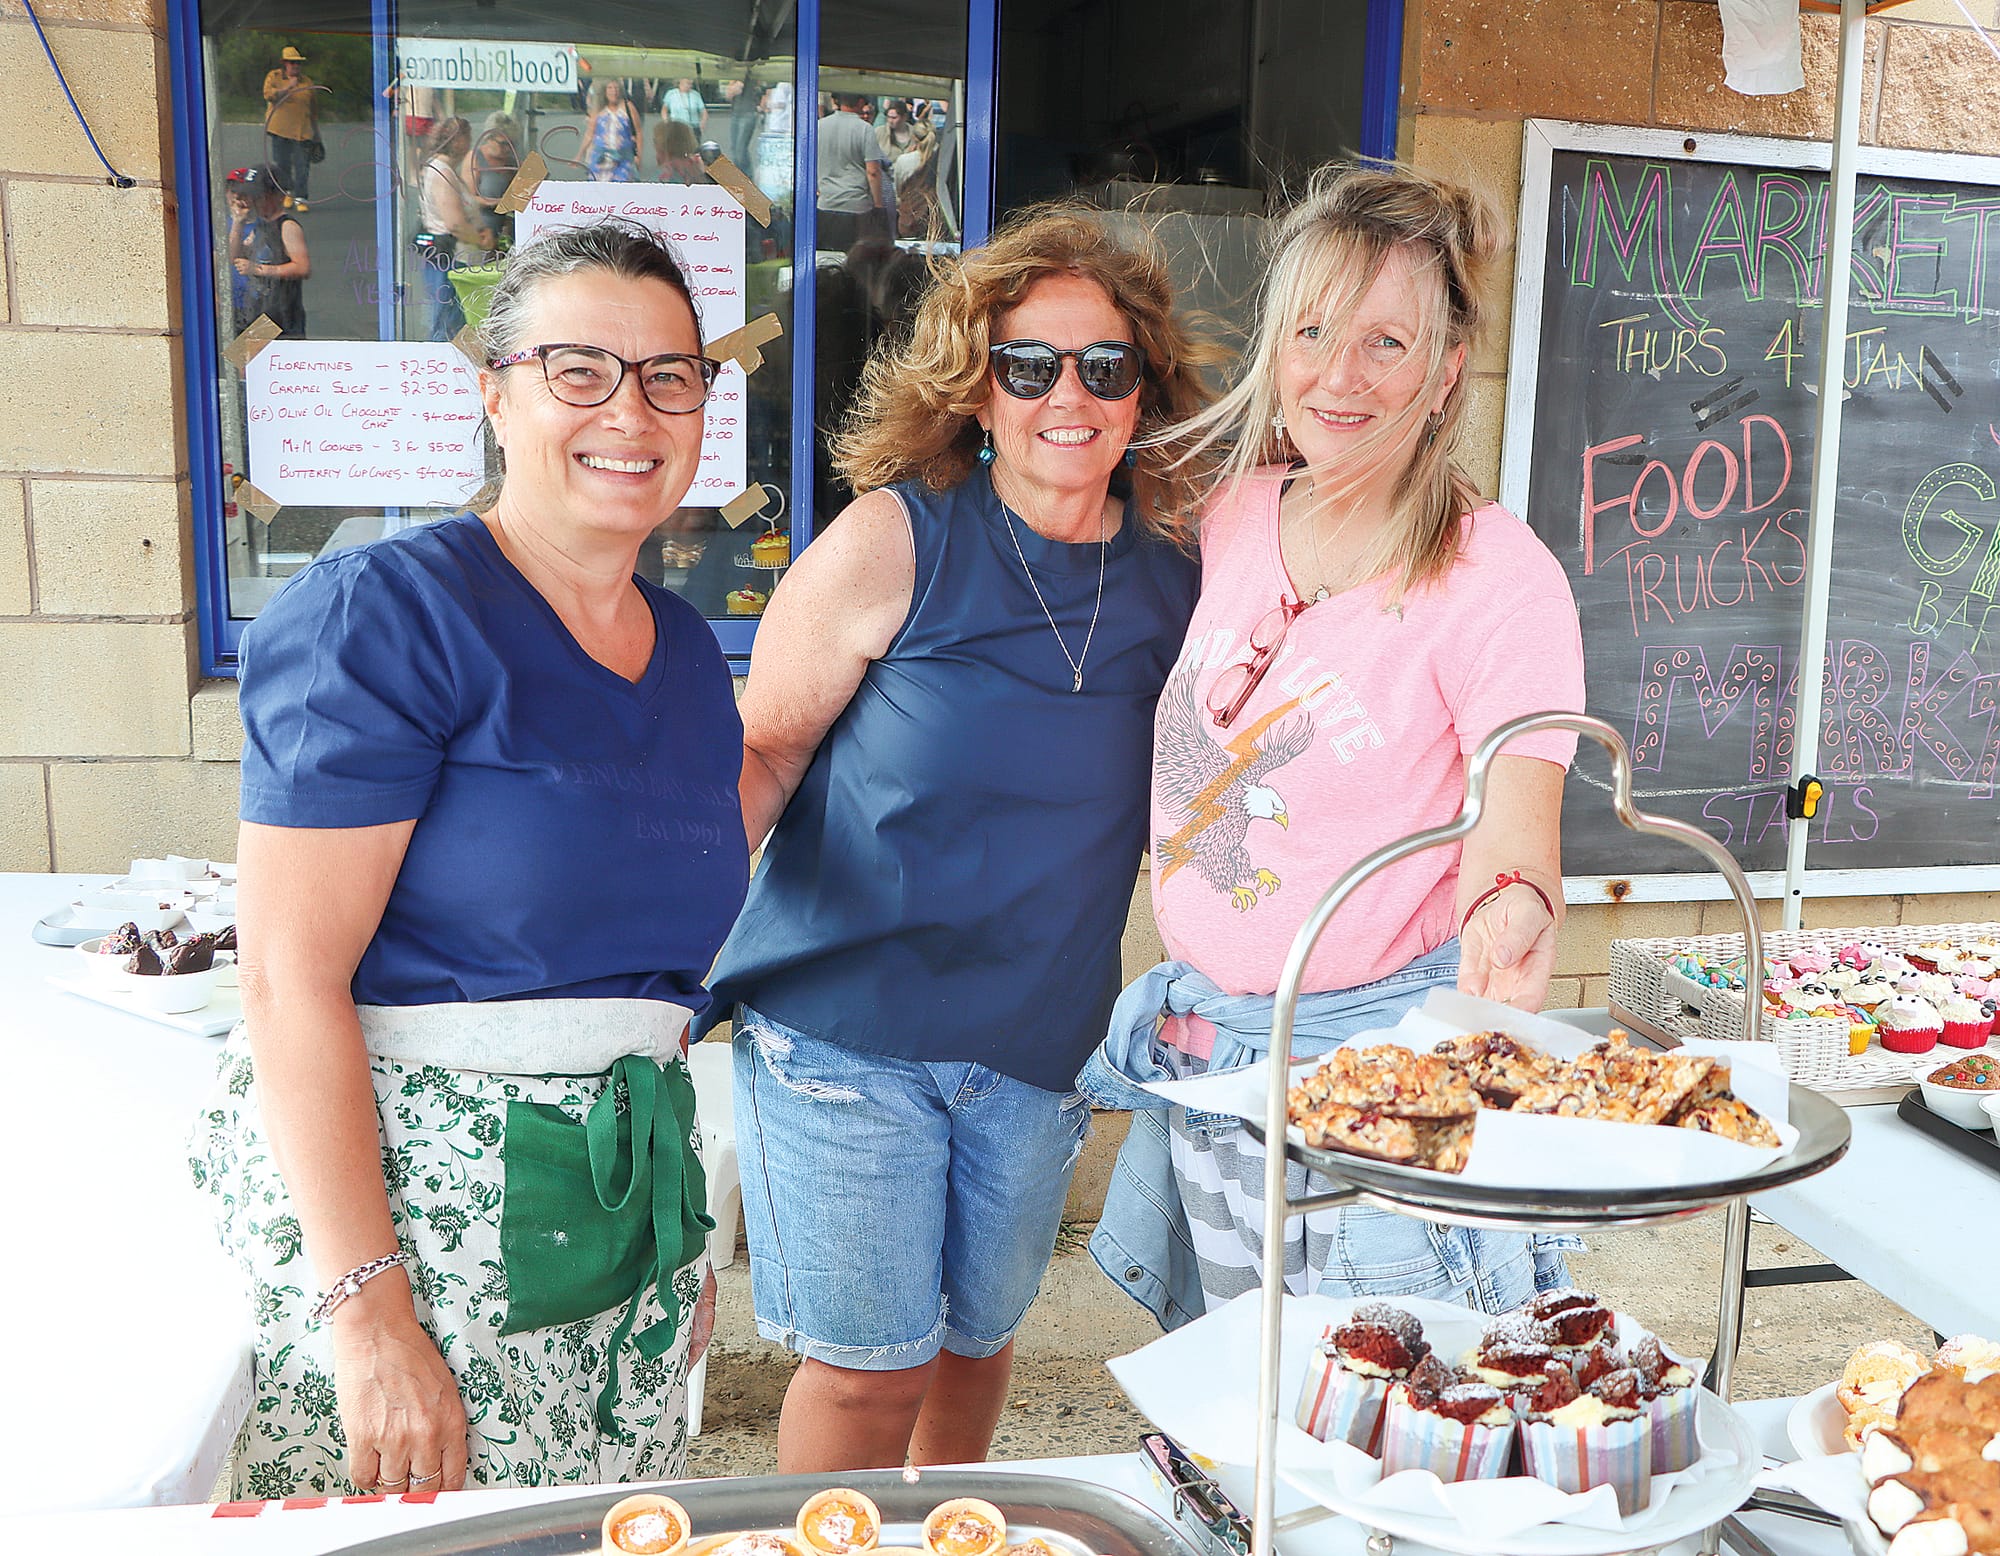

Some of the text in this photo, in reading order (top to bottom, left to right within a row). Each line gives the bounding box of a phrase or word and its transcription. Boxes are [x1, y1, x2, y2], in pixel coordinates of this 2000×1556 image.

[531, 196, 566, 213] FUDGE
[571, 200, 616, 214] BROWNIE
[680, 205, 690, 216] 2
[693, 231, 719, 241] each
[1571, 159, 2000, 330] MARKET
[711, 264, 733, 274] each
[1600, 313, 1925, 391] THURS 4 JAN
[269, 355, 353, 372] FLORENTINES
[269, 381, 321, 394] CARAMEL
[332, 381, 370, 394] SLICE
[249, 405, 274, 422] (GF)
[278, 407, 309, 419] OLIVE
[314, 404, 334, 417] OIL
[342, 403, 402, 418] CHOCOLATE
[362, 418, 394, 430] CAKE
[282, 439, 312, 453] M+M
[319, 440, 364, 452] COOKIES
[392, 440, 401, 452] 3
[280, 464, 341, 479] BUTTERFLY
[1581, 415, 1792, 575] FOOD
[1600, 510, 1807, 637] TRUCKS
[1279, 656, 1385, 765] LOVE
[1703, 787, 1879, 845] STALS
[635, 812, 669, 841] Est
